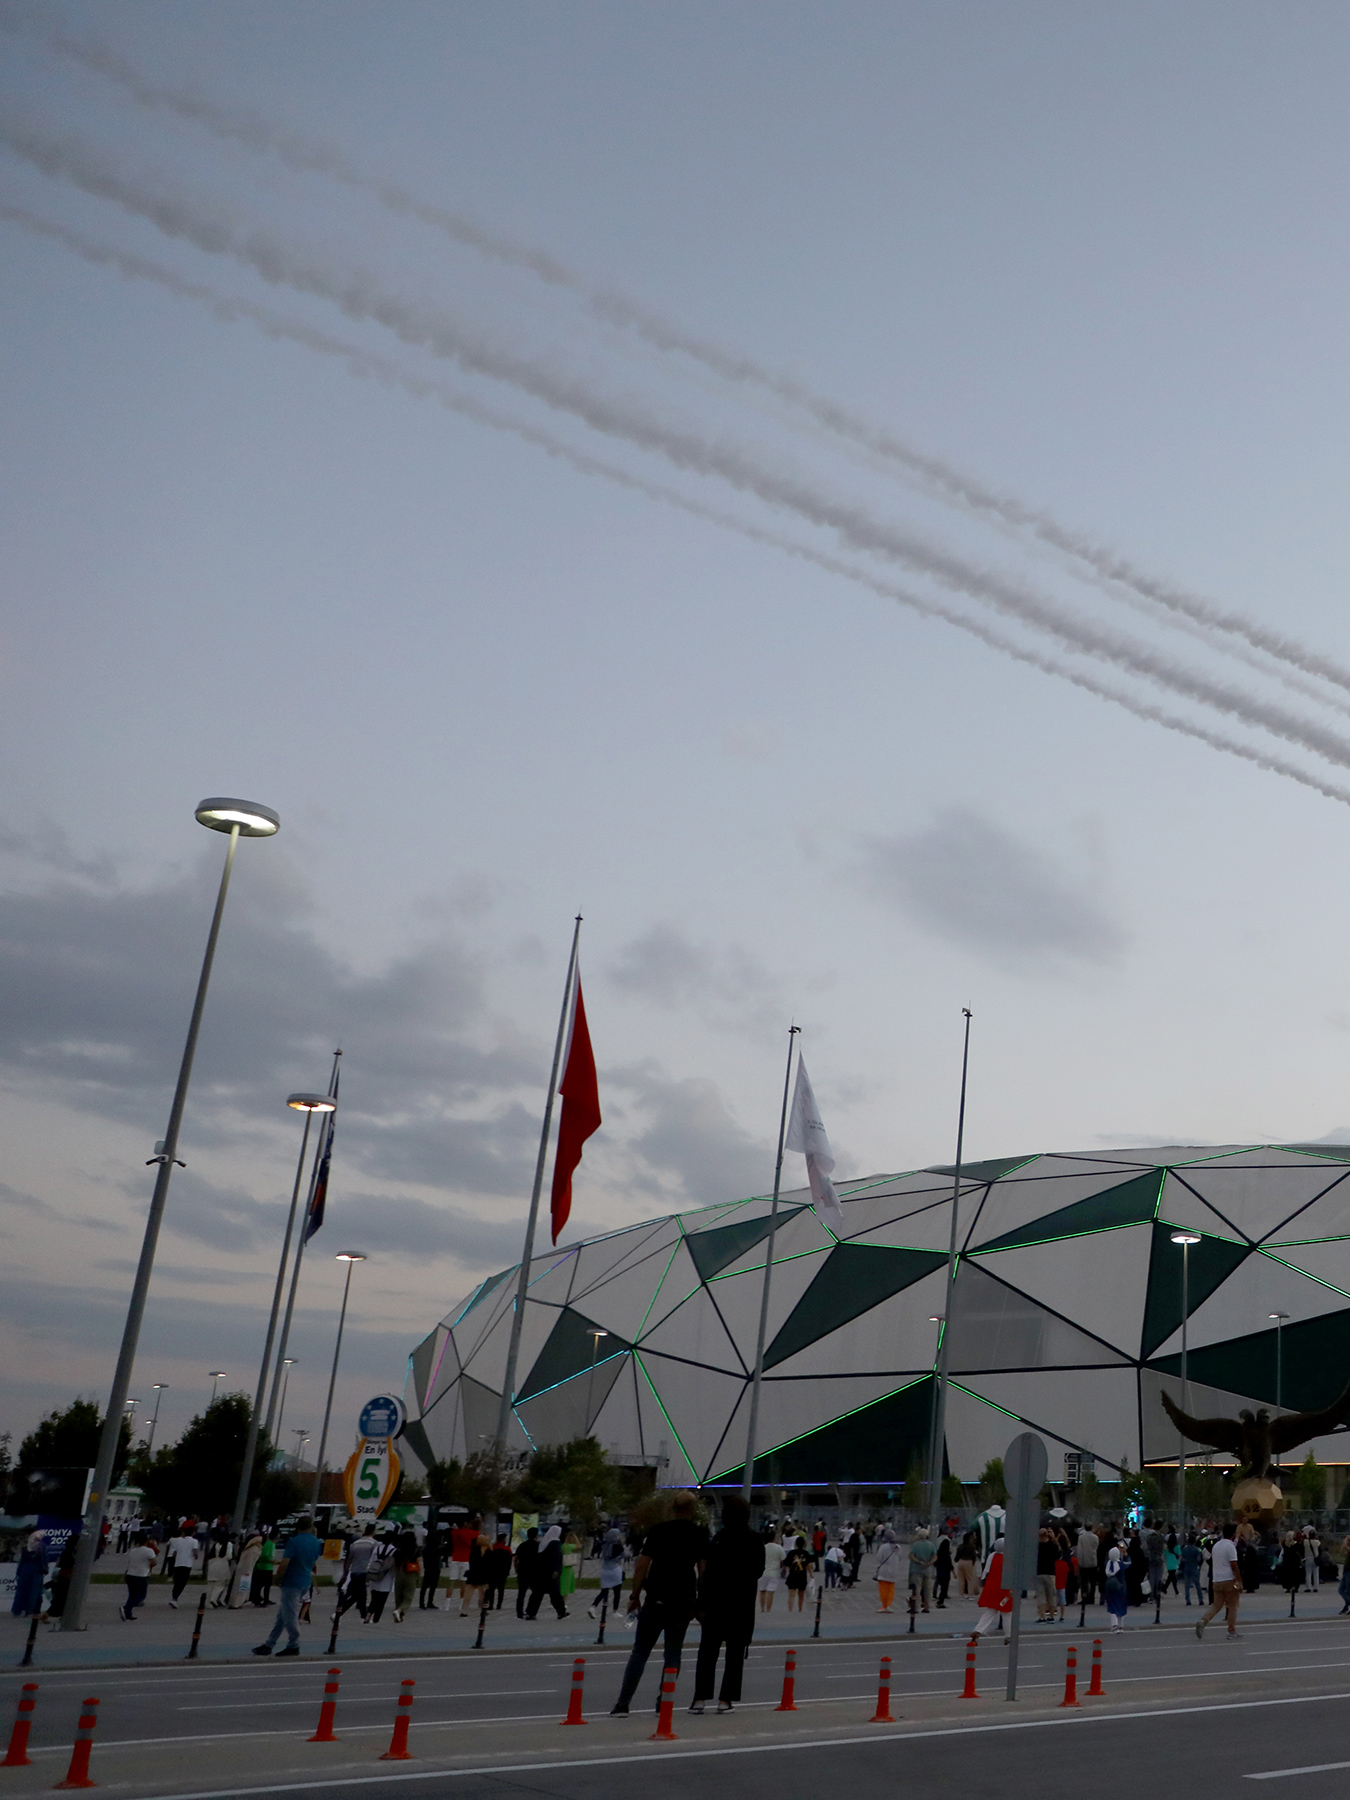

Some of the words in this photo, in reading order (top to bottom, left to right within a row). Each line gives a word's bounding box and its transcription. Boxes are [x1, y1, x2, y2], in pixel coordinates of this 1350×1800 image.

[365, 1445, 375, 1454] En
[357, 1458, 380, 1499] 5.
[50, 1536, 69, 1545] 202
